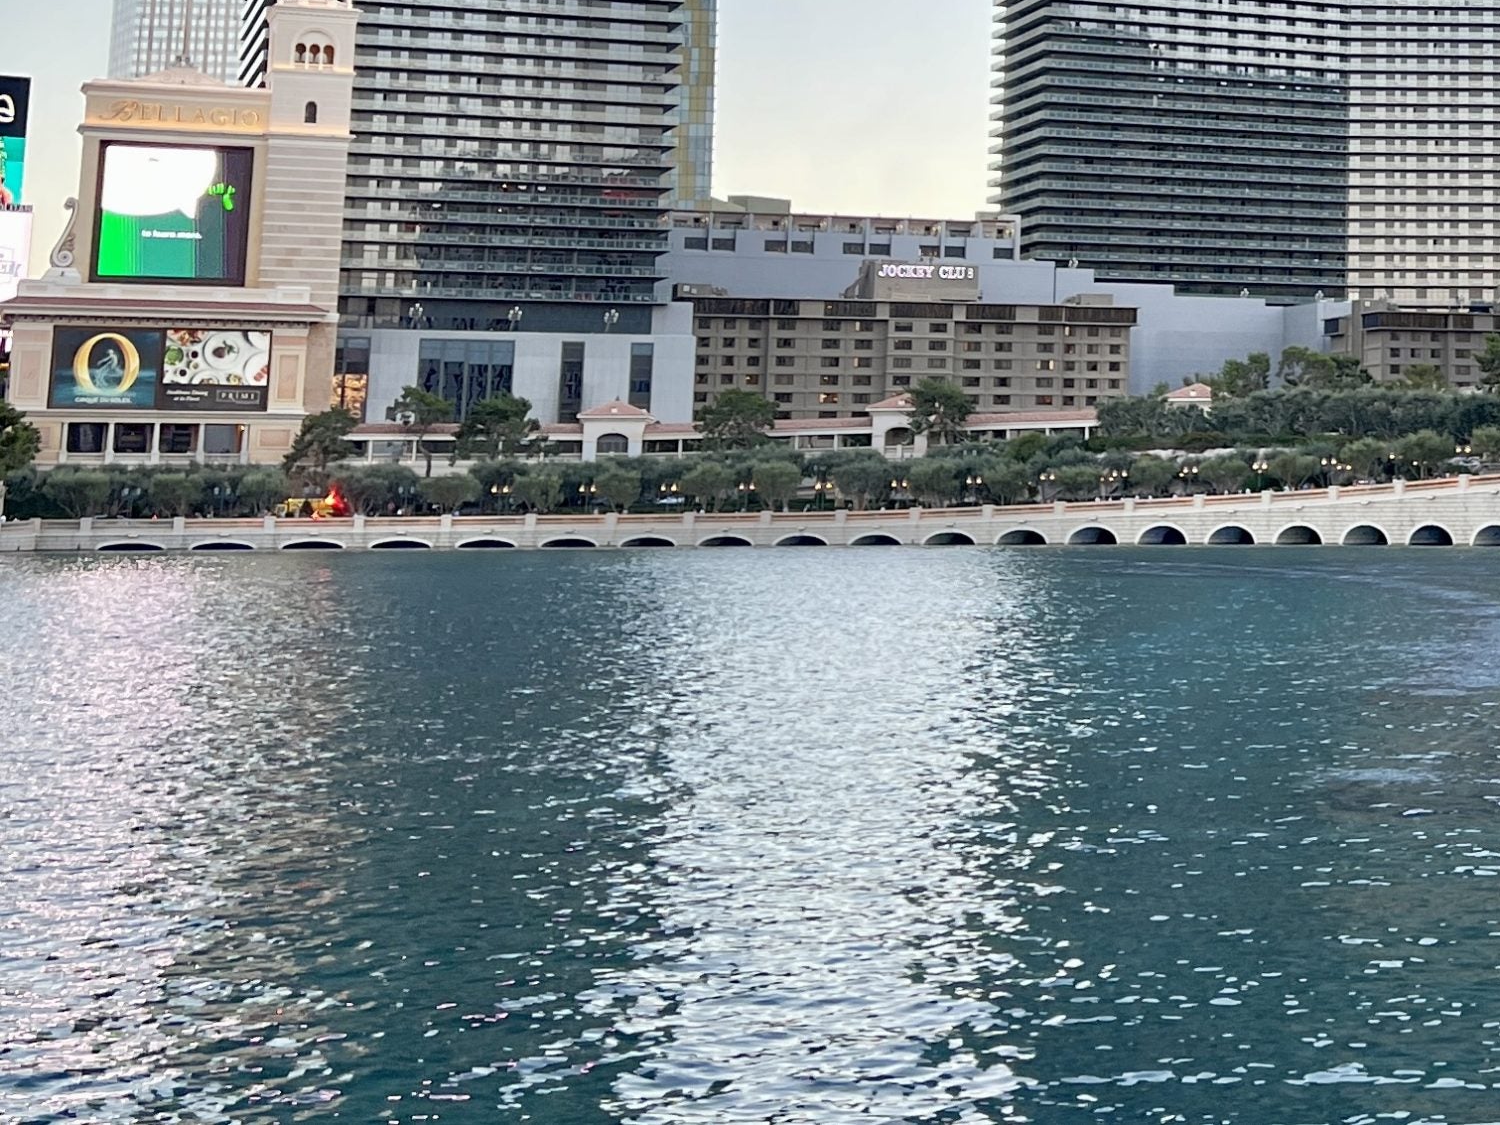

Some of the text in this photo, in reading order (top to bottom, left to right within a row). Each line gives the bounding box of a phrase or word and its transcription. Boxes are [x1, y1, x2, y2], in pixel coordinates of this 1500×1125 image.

[99, 97, 260, 126] BELLAGIO
[878, 264, 974, 279] JOCKEY CLUB
